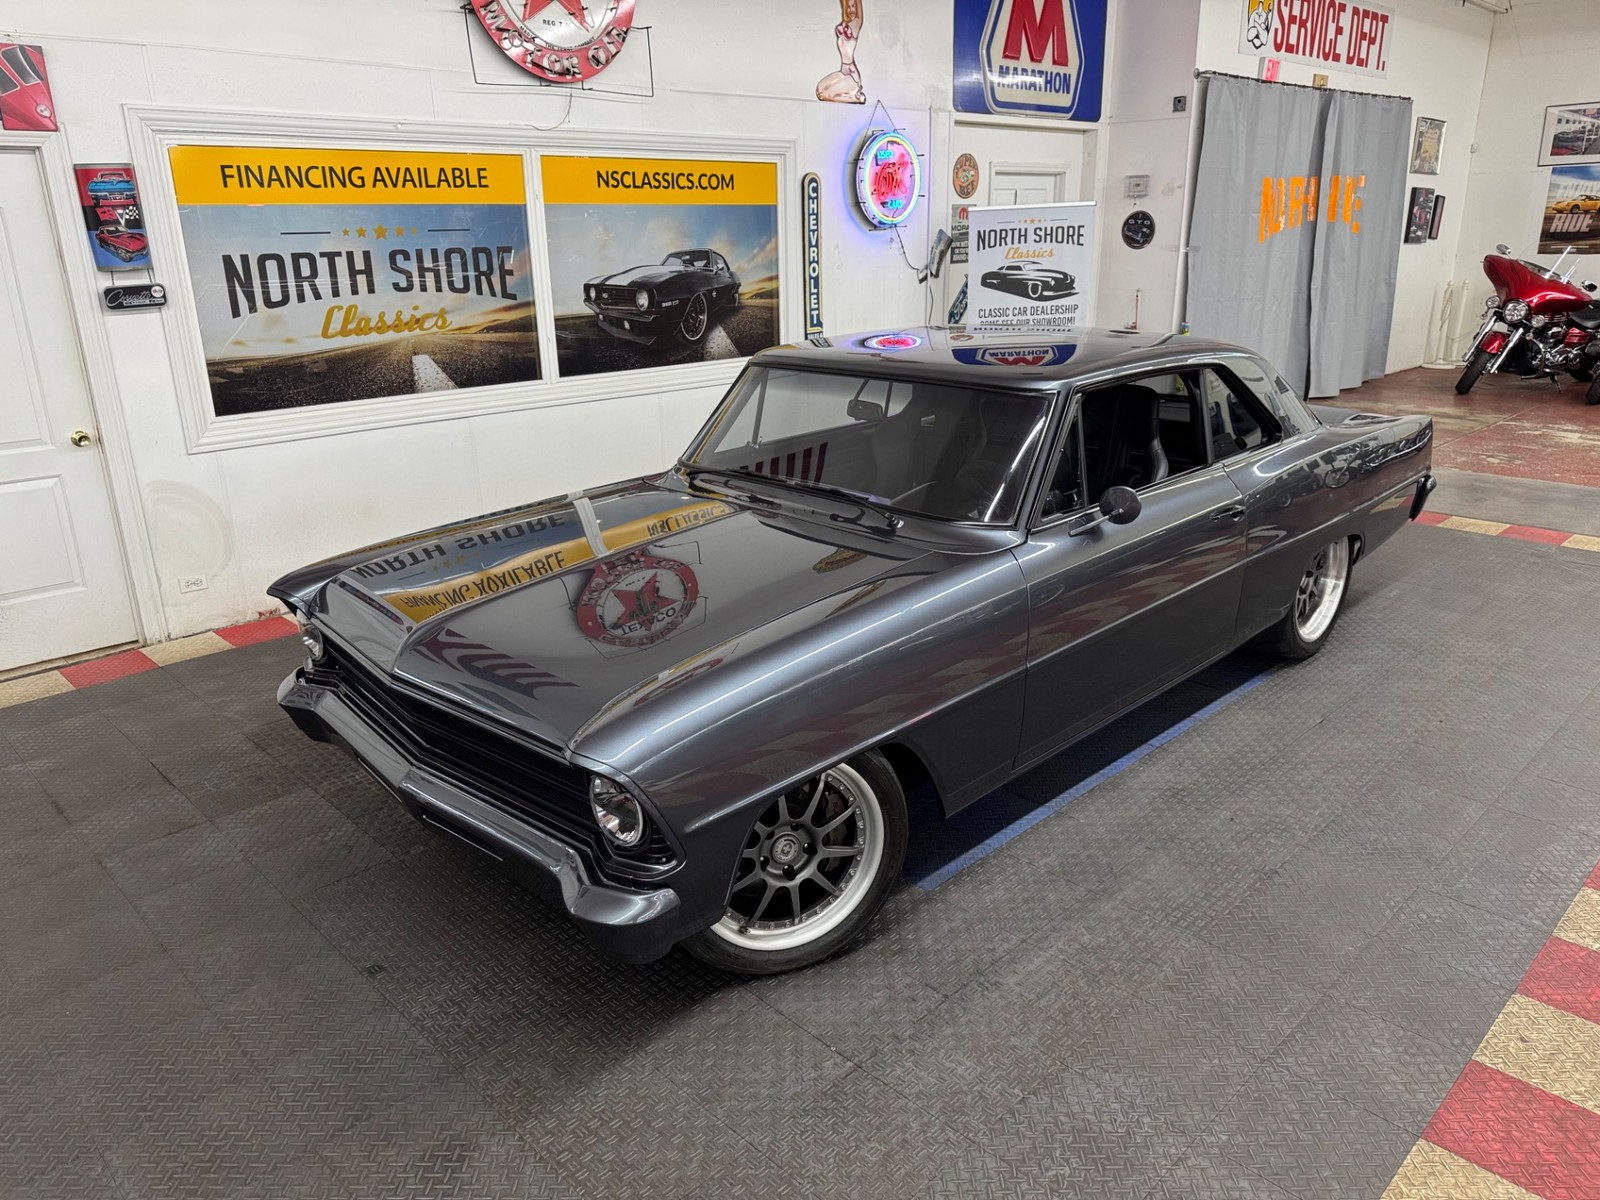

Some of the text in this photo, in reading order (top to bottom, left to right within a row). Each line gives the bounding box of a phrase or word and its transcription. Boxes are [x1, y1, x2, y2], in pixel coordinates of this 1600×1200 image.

[1273, 0, 1390, 72] SERVICE DEPT.
[996, 64, 1071, 95] MARATHON
[954, 154, 978, 172] SUPER
[219, 163, 490, 189] FINANCING AVAILABLE
[596, 169, 735, 191] NSCLASSICS.COM
[958, 180, 977, 196] BEE
[951, 223, 969, 232] MOPA
[1128, 218, 1151, 226] GTO
[1549, 213, 1593, 233] RIDE
[976, 224, 1085, 252] NORTH SHORE
[808, 182, 820, 326] CHEVROLET
[1004, 247, 1055, 260] Classics
[221, 245, 518, 320] NORTH SHORE
[106, 289, 152, 307] Corvette
[978, 303, 1079, 319] CLASSIC CAR DEALERSHIP
[1032, 316, 1076, 326] SHOWROOM!
[320, 304, 453, 340] Classics
